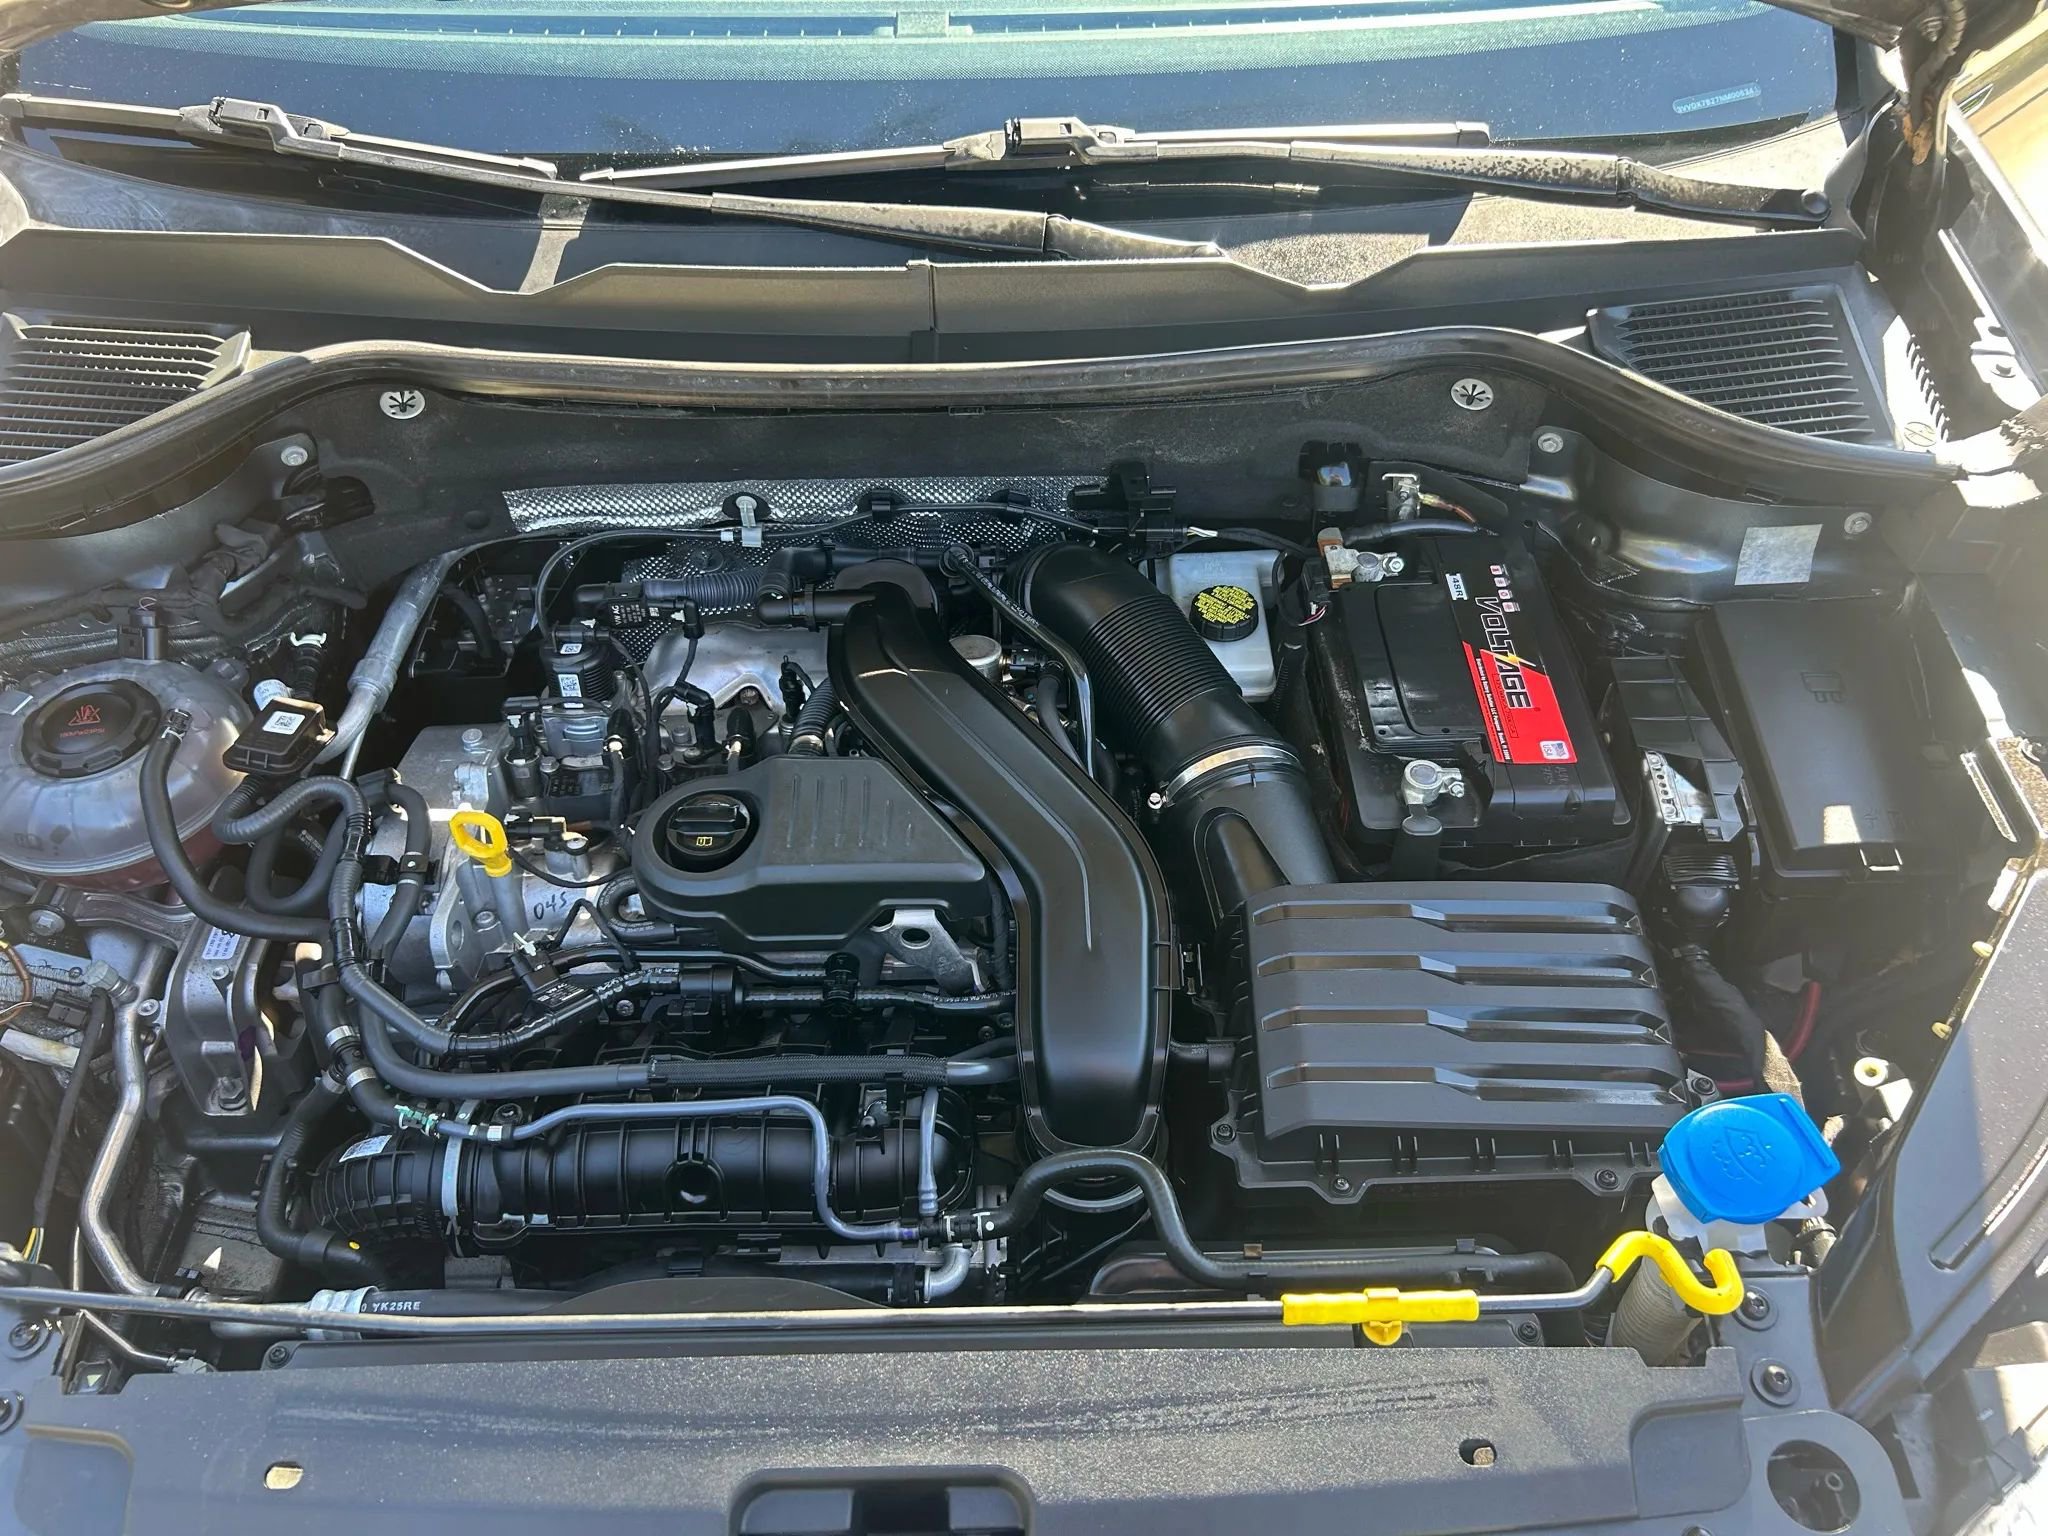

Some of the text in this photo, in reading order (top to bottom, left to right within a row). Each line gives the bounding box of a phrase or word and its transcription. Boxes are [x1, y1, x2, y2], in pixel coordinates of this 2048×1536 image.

[1452, 577, 1464, 597] 48R
[1475, 597, 1533, 709] VOLTAGE
[1542, 744, 1553, 756] USA
[372, 1301, 421, 1312] YK25RE
